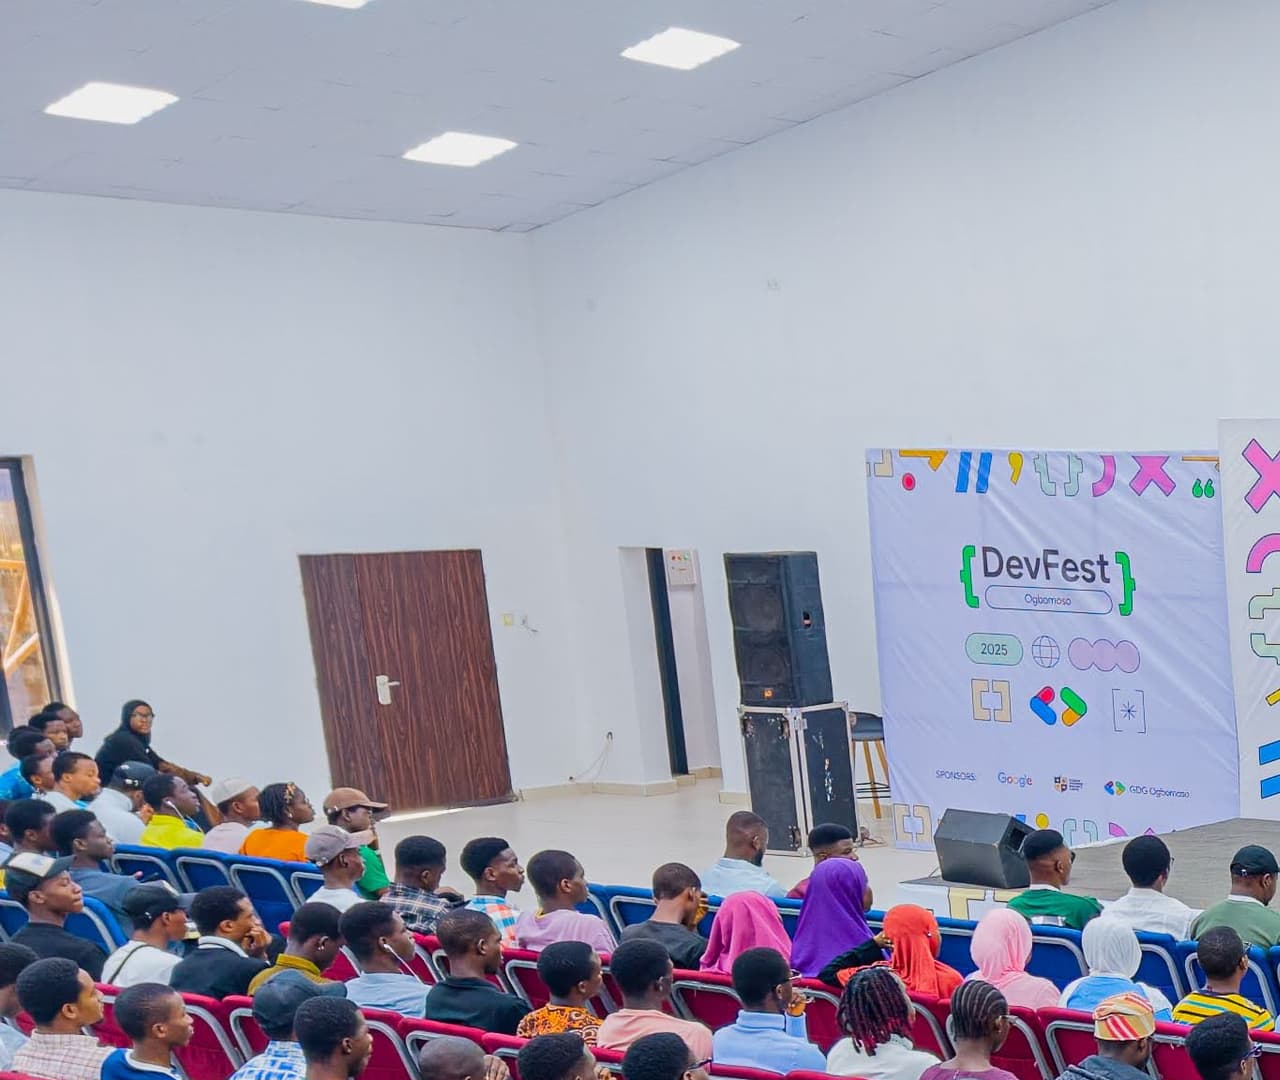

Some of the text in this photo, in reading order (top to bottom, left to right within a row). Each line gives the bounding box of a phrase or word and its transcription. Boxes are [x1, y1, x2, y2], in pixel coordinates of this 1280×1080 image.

[981, 546, 1111, 583] DevFest
[1024, 593, 1072, 607] Ogbomoso
[980, 642, 1008, 656] 2025
[997, 771, 1033, 788] Google
[1128, 784, 1149, 795] GDG
